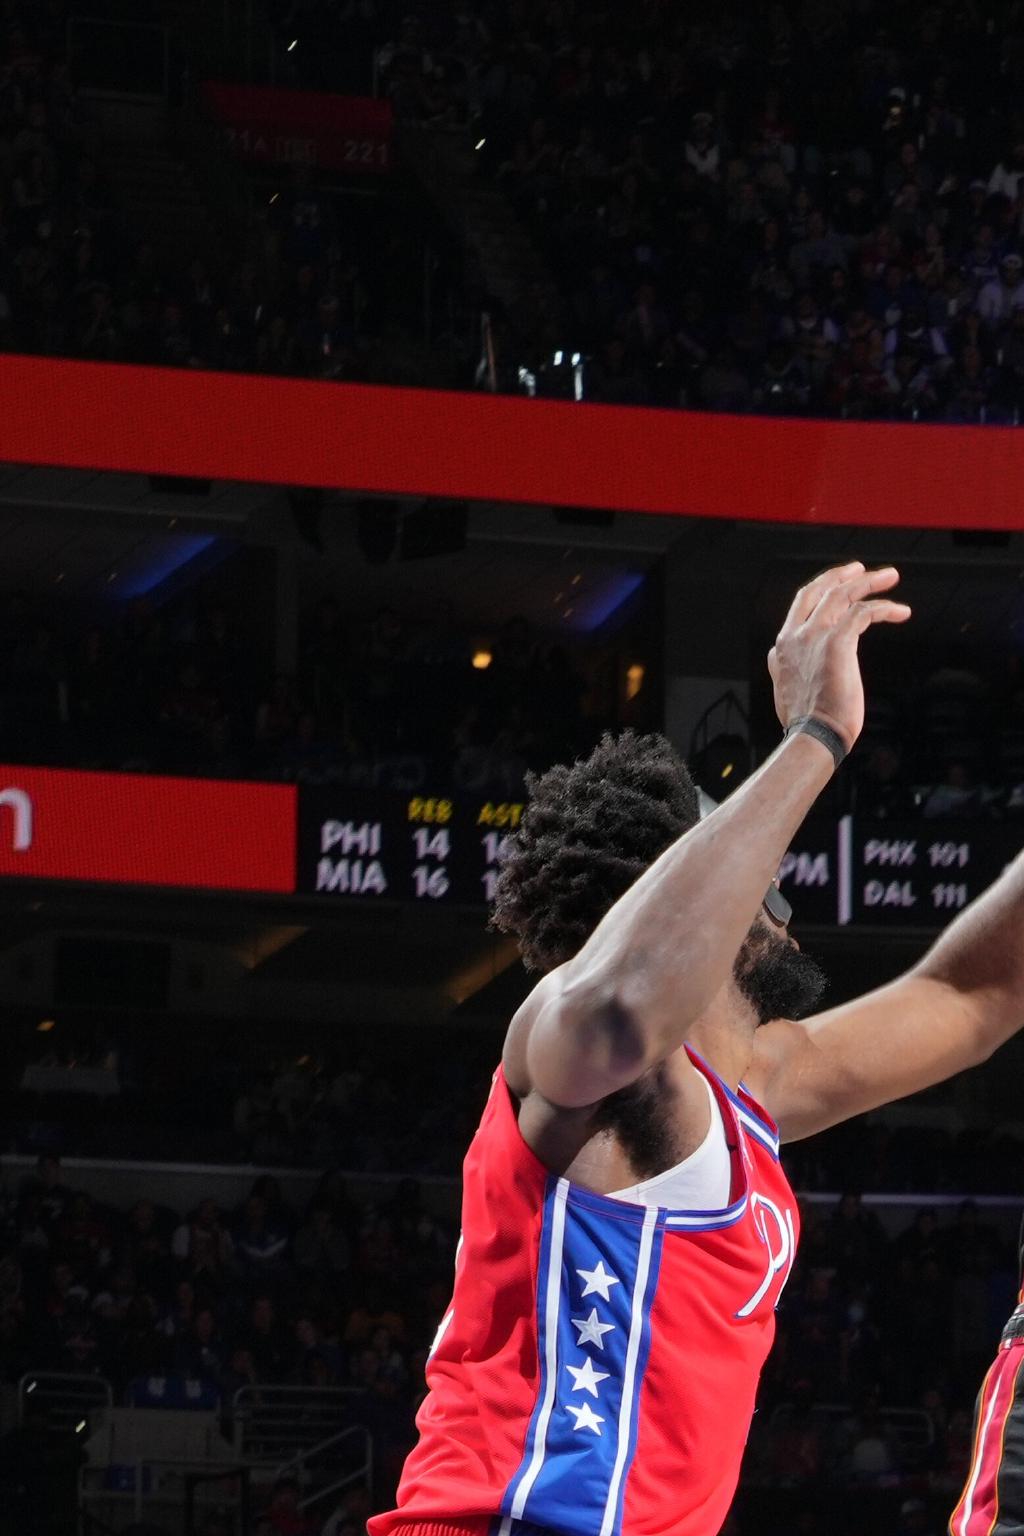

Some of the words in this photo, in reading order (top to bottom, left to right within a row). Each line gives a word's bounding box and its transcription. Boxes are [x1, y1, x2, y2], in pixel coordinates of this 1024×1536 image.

[320, 819, 383, 857] PHI
[411, 827, 450, 862] 14
[315, 855, 389, 896] MIA
[411, 864, 450, 899] 16
[863, 880, 916, 907] DAL
[931, 882, 968, 908] 111
